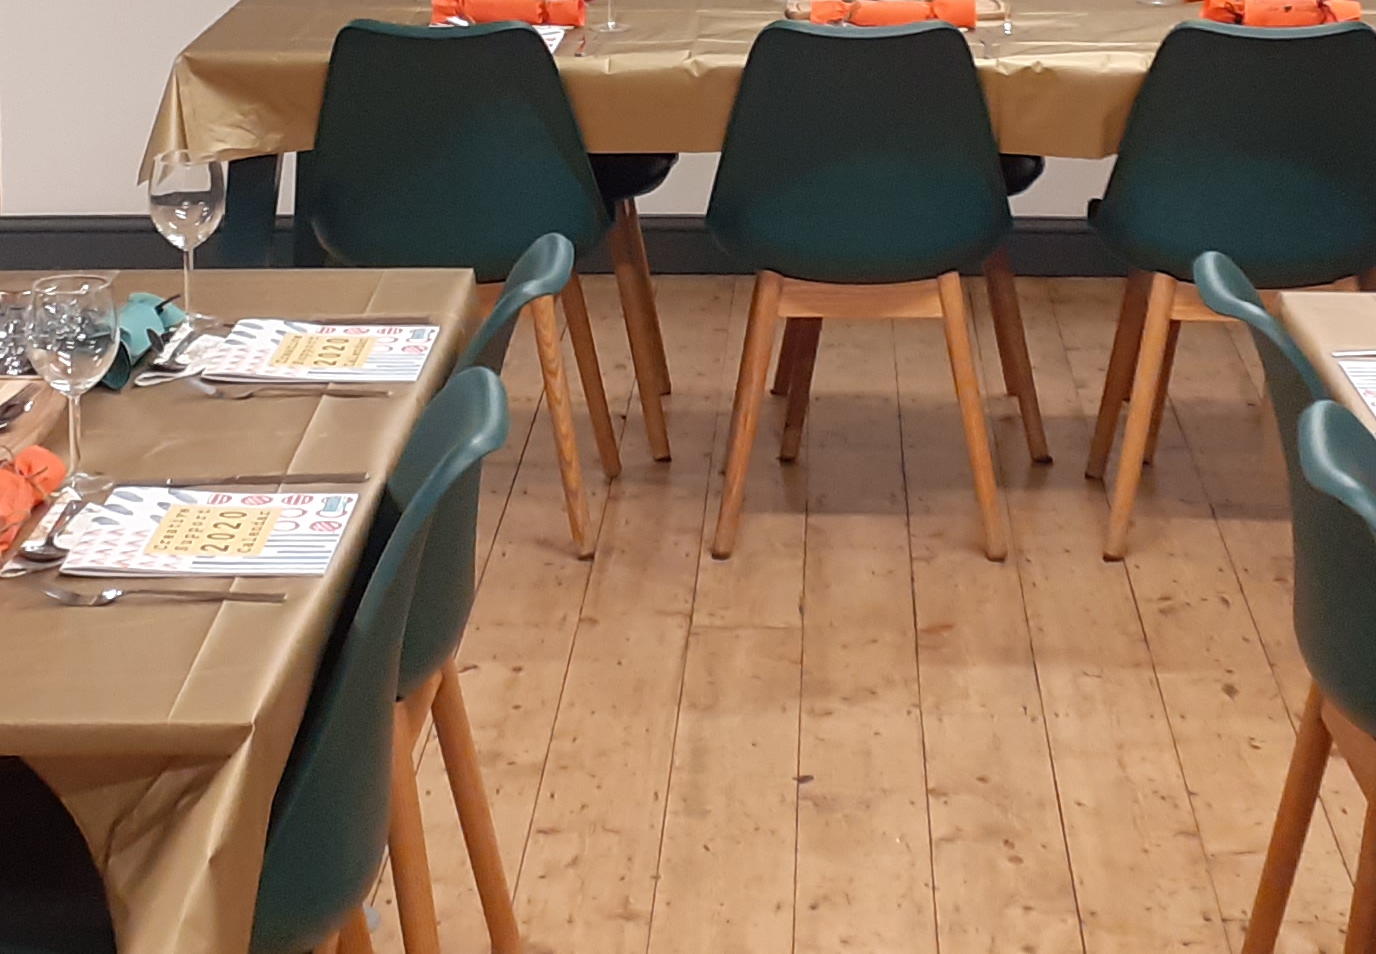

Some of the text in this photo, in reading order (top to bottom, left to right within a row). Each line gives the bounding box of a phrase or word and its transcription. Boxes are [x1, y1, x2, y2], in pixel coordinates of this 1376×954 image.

[313, 338, 349, 366] 2020
[153, 508, 190, 551] Creative
[174, 509, 210, 551] Support
[200, 511, 248, 552] 2020
[237, 510, 271, 553] Calendar
